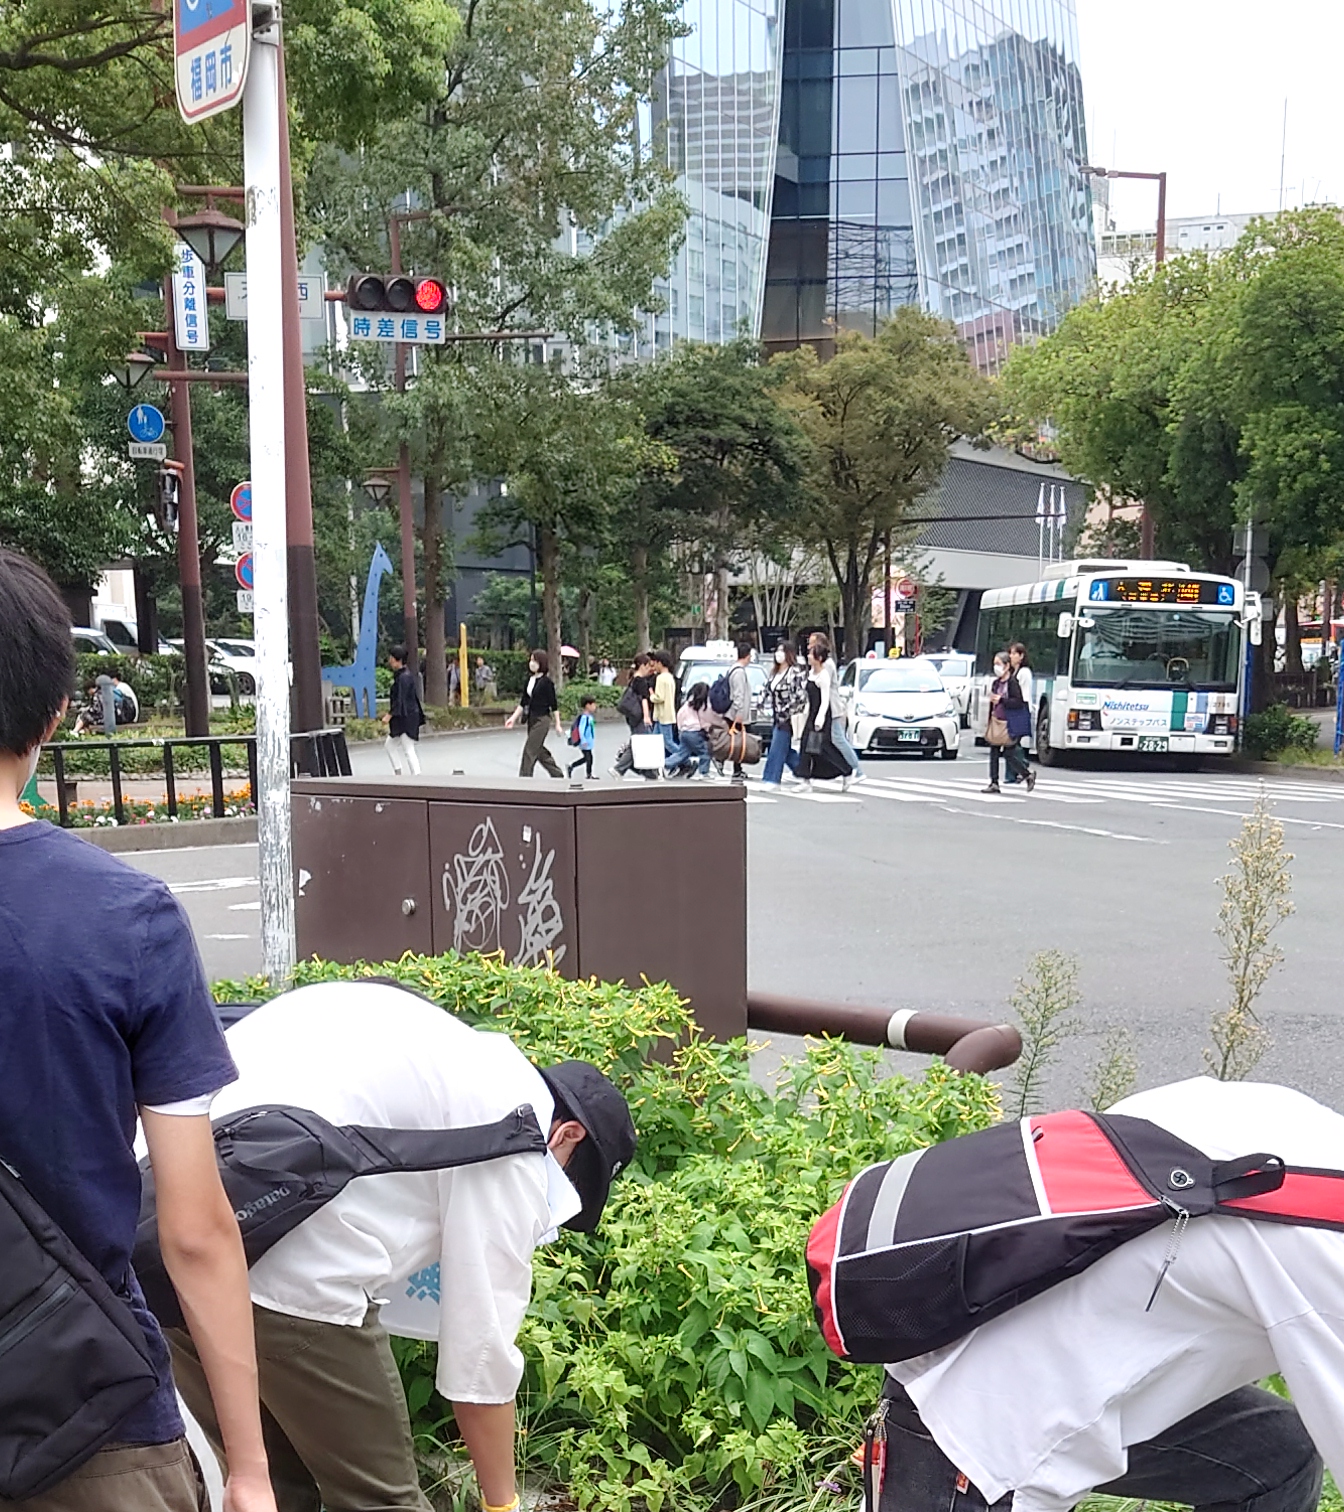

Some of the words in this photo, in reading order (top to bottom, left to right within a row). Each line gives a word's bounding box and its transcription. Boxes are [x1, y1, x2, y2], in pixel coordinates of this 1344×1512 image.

[191, 44, 232, 103] 福岡市
[181, 249, 198, 344] 歩車分離信号
[353, 317, 442, 340] 時差信号
[1102, 701, 1149, 712] Nishitetsu
[1110, 717, 1168, 727] ノンステップバス
[236, 1184, 291, 1220] patago
